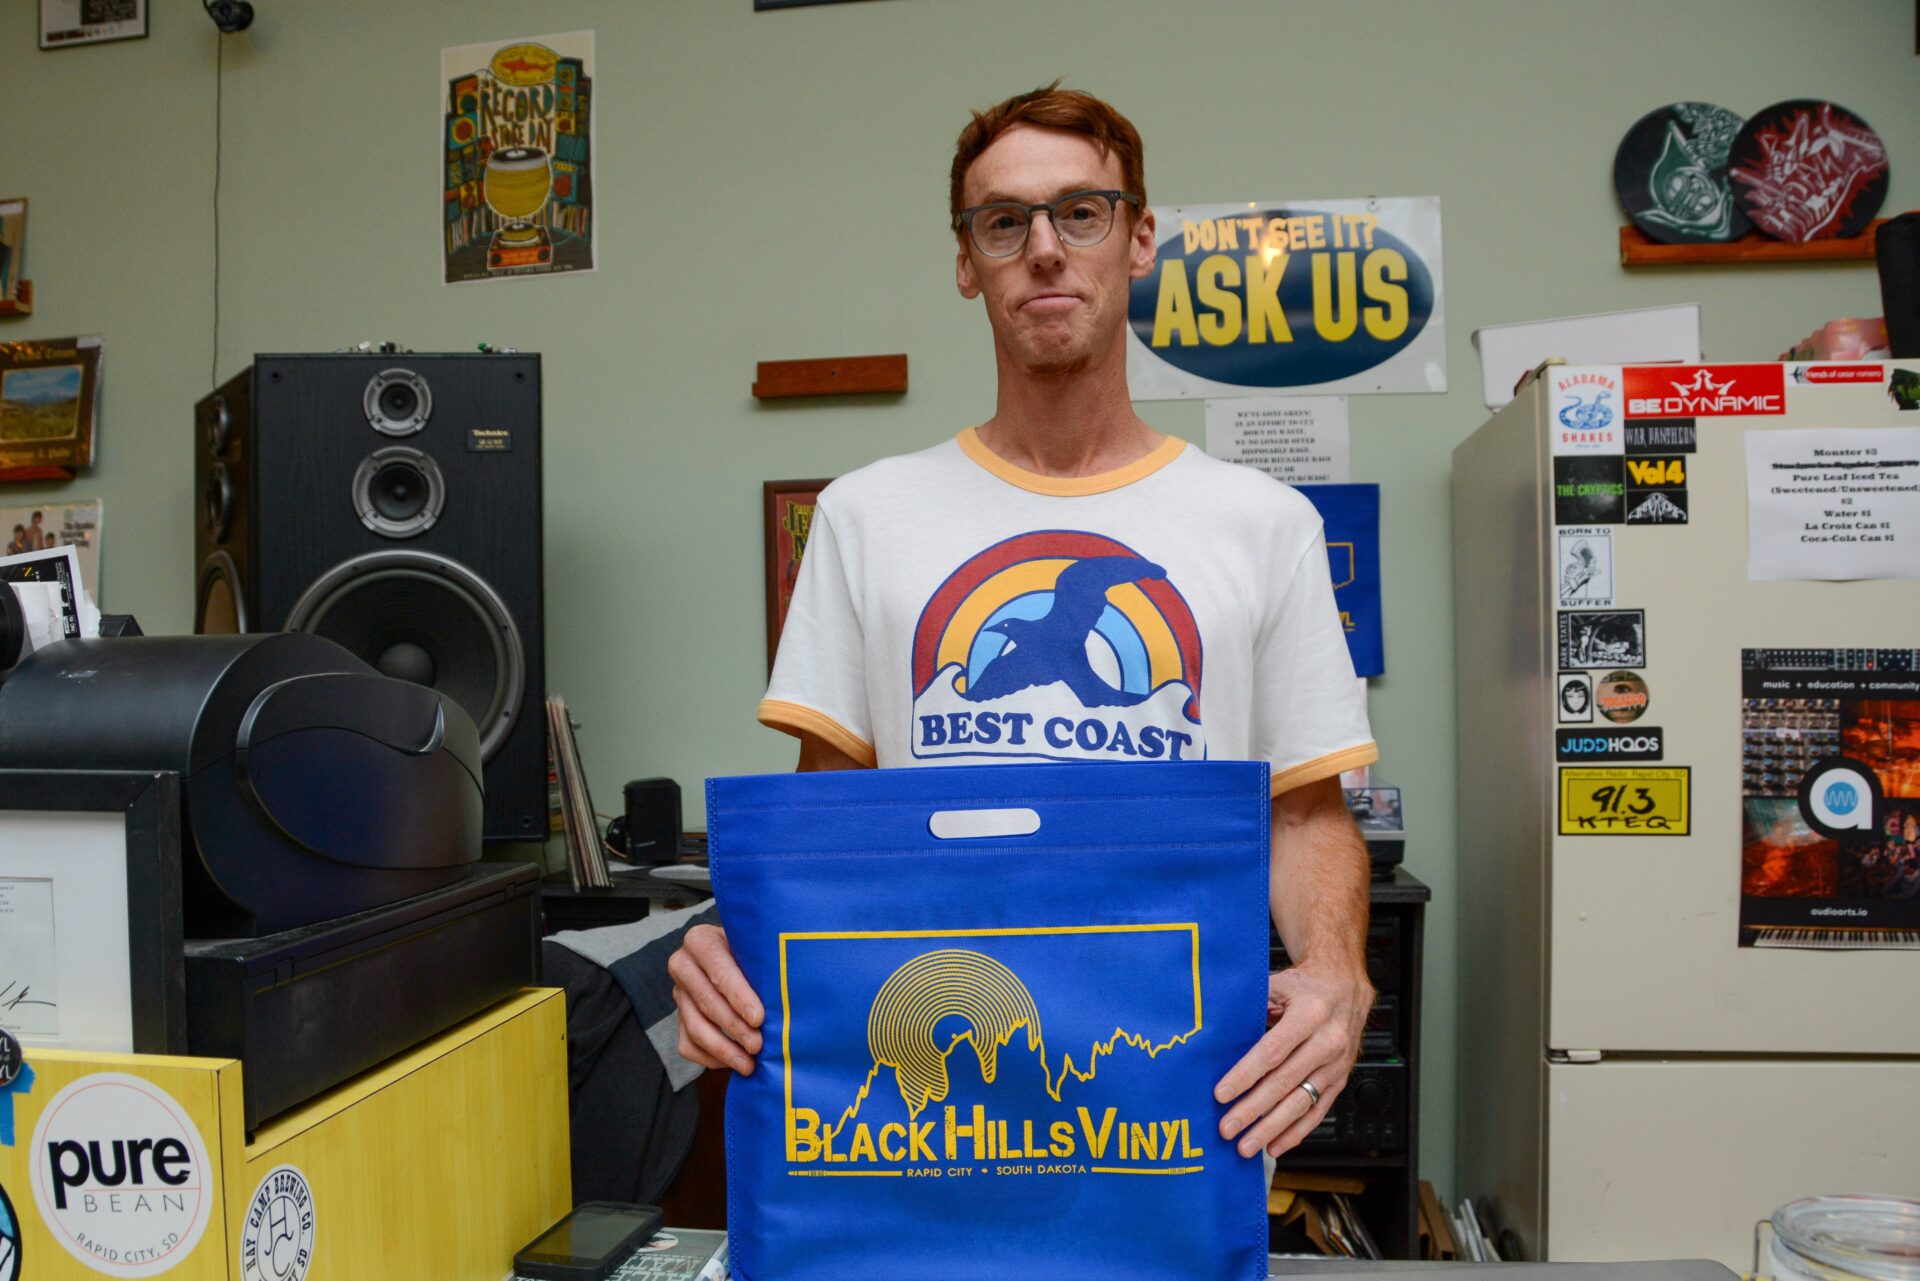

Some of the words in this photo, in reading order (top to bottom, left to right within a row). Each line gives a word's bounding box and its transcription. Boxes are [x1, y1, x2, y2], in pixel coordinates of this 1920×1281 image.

[479, 82, 554, 136] RECORD
[1182, 215, 1264, 255] DON'T
[1270, 213, 1327, 251] SEE
[1332, 213, 1380, 250] IT?
[1151, 253, 1294, 348] ASK
[1311, 248, 1410, 342] US
[1558, 373, 1616, 391] ALABAMA
[1628, 397, 1662, 414] BE
[1664, 395, 1780, 413] DYNAMIC
[1562, 432, 1613, 443] SHAKES
[1792, 474, 1820, 482] Pure
[1823, 473, 1849, 481] Leaf
[1878, 472, 1900, 480] Tea
[1557, 484, 1576, 497] THE
[1577, 483, 1625, 497] CRYPTICS
[1596, 527, 1611, 535] TO
[1805, 522, 1819, 530] La
[1821, 522, 1852, 530] Croix
[1801, 534, 1857, 542] Coca-Cola
[1560, 599, 1612, 607] SUFFER
[1559, 614, 1569, 644] STATES
[1762, 680, 1791, 690] music
[1807, 680, 1856, 690] education
[1868, 681, 1920, 693] community
[919, 711, 1034, 747] BEST
[1044, 716, 1192, 761] COAST
[1591, 784, 1656, 815] 91.3
[1578, 815, 1672, 830] KTEQ
[1810, 906, 1868, 917] audioarts.io
[785, 1106, 938, 1163] BLACK
[944, 1104, 1076, 1161] HILLS
[1076, 1106, 1204, 1161] VINYL
[48, 1137, 191, 1210] pure
[906, 1167, 942, 1178] RAPID
[947, 1166, 974, 1177] CITY
[996, 1165, 1033, 1176] SOUTH
[1037, 1164, 1087, 1175] DAKOTA
[274, 1174, 308, 1209] BREWING
[83, 1192, 185, 1214] BEAN
[250, 1185, 271, 1229] CAMP
[76, 1231, 119, 1262] RAPID
[124, 1248, 161, 1264] CITY,
[161, 1231, 180, 1251] SD
[246, 1238, 256, 1272] HAY
